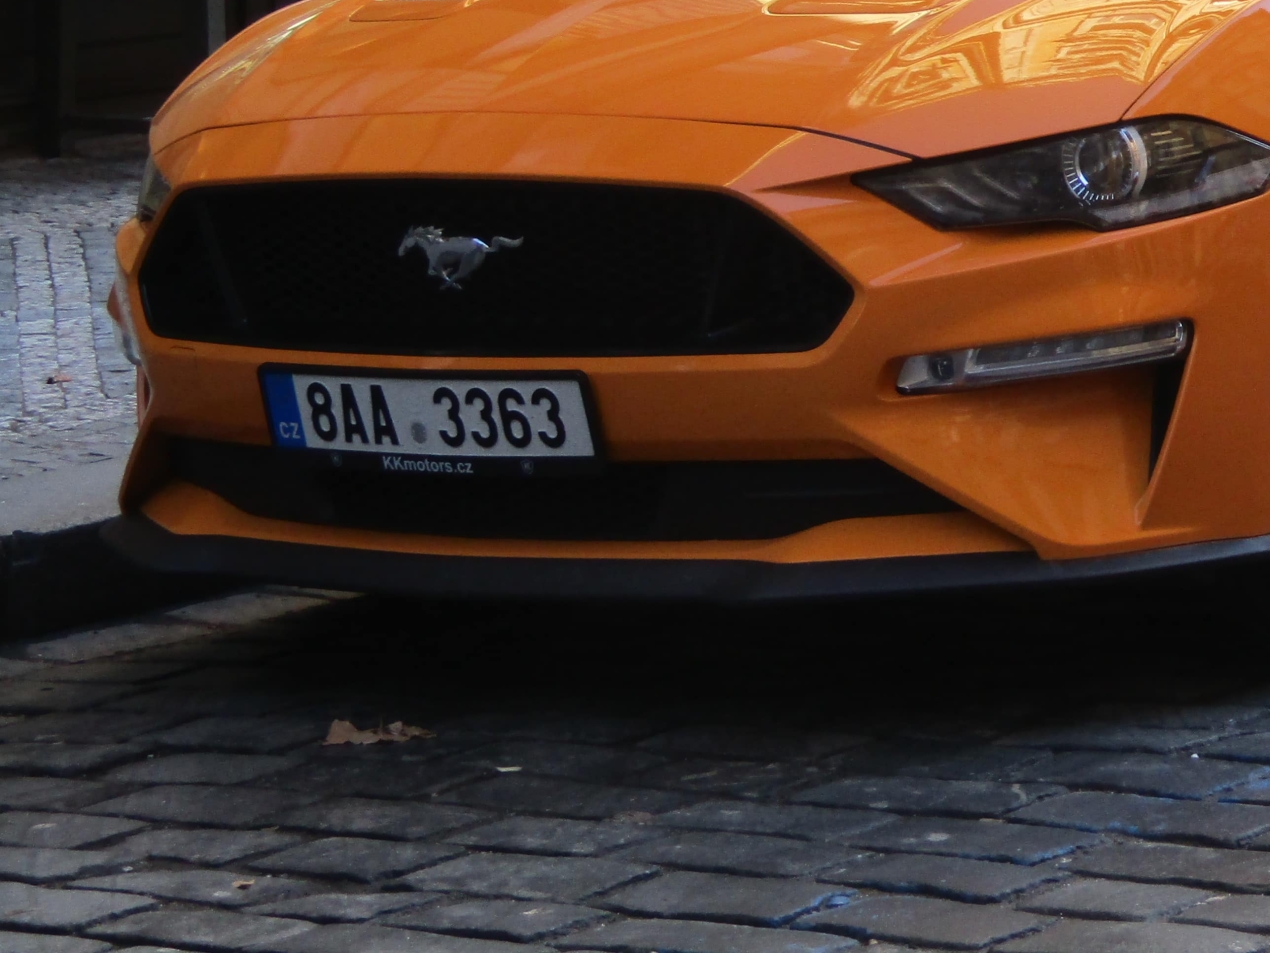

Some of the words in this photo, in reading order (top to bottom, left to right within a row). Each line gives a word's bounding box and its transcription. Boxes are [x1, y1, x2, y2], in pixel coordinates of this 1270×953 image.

[279, 422, 301, 439] CZ
[306, 381, 400, 446] 8AA
[432, 386, 567, 449] 3363
[382, 455, 474, 475] KKmotors.cz
